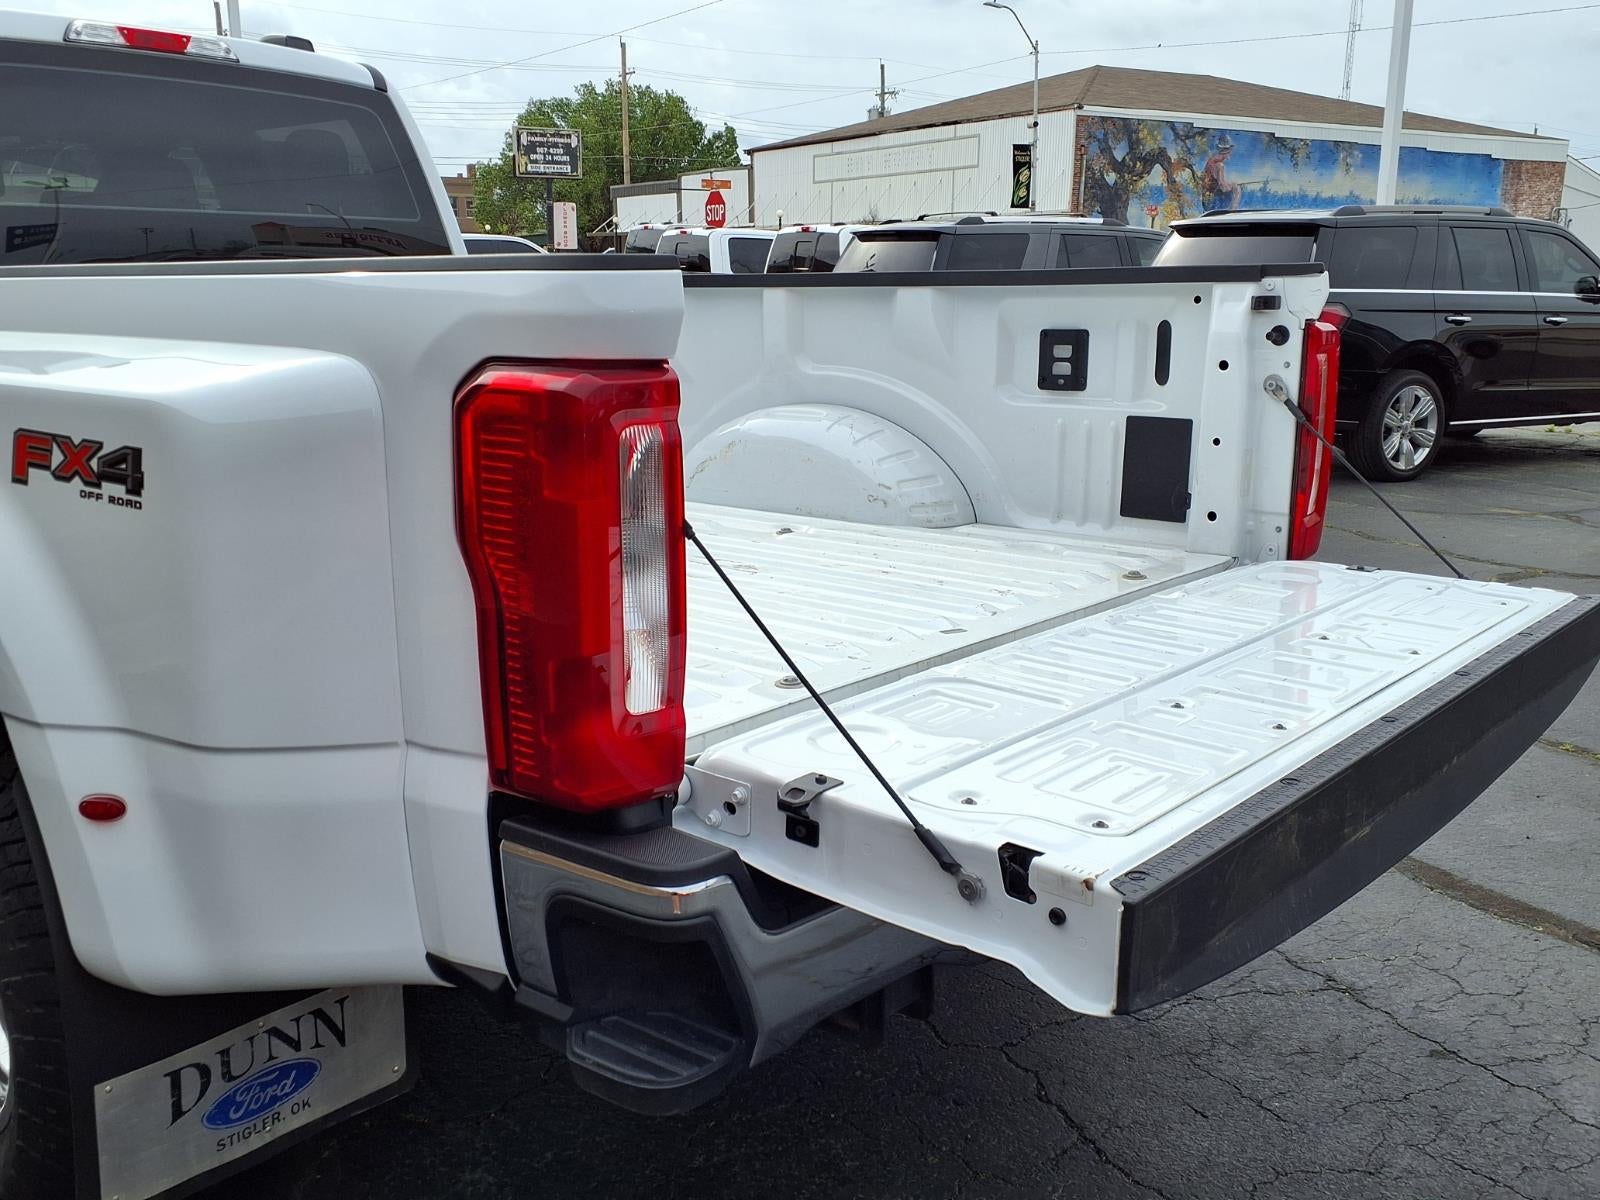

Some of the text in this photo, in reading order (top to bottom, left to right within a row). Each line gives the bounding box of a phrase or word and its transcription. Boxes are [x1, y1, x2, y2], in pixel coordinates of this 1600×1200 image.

[706, 204, 725, 222] STOP
[11, 427, 144, 498] FX4
[79, 489, 142, 511] OFF ROAD
[163, 995, 350, 1130] DUNN
[229, 1069, 297, 1120] Ford
[290, 1097, 312, 1115] OK
